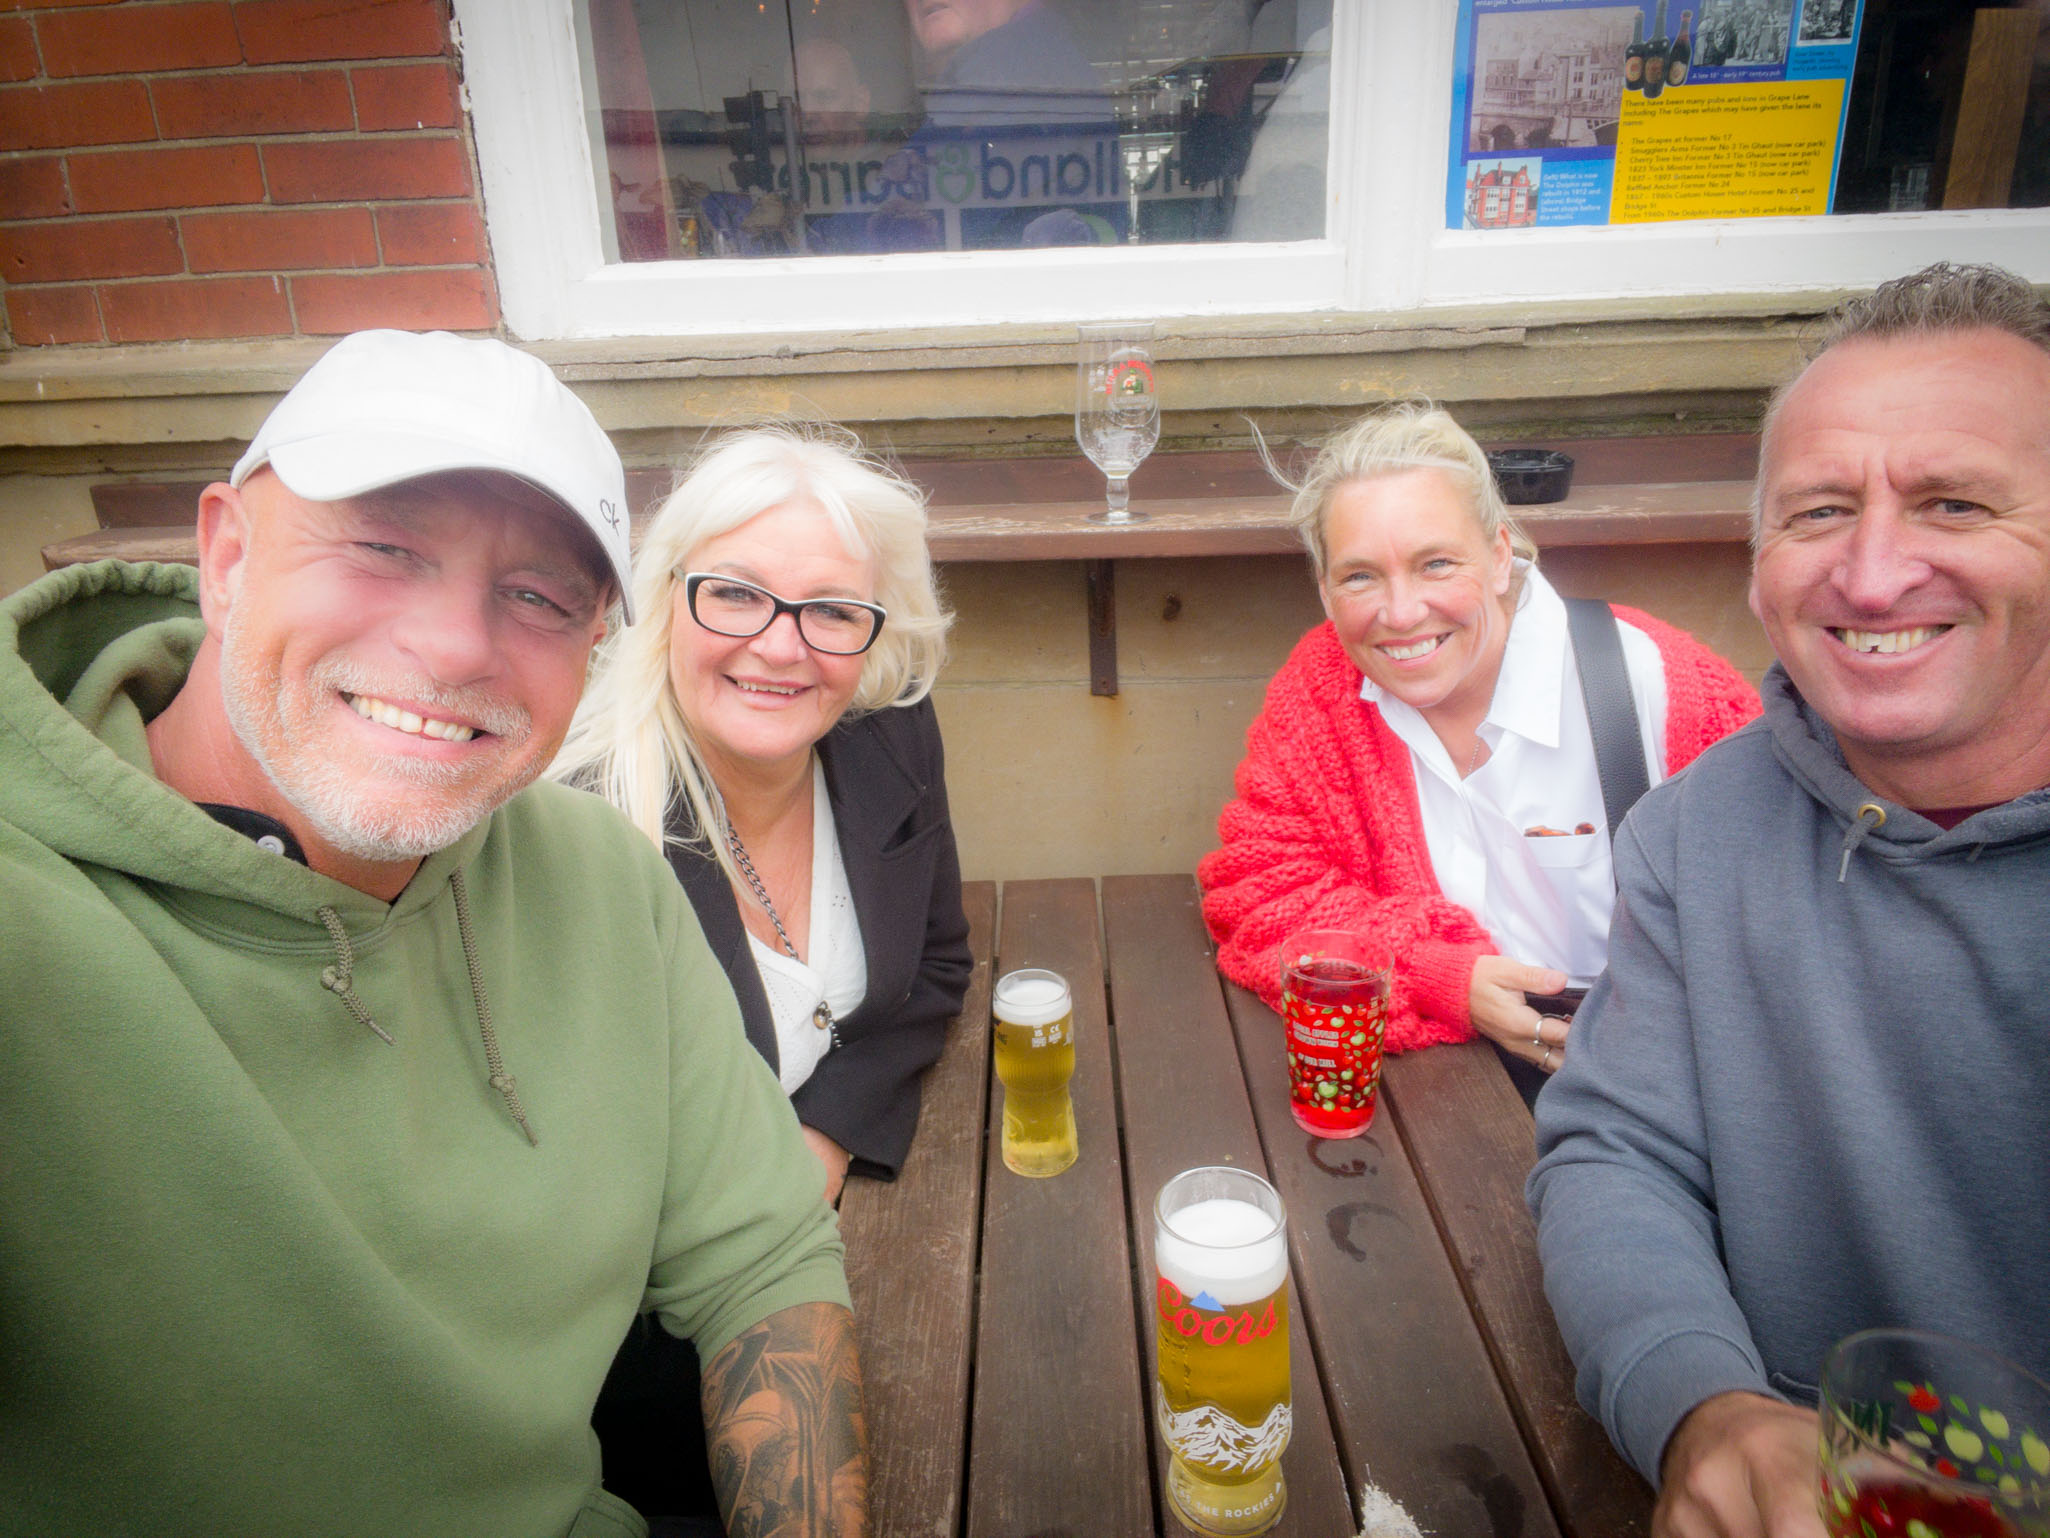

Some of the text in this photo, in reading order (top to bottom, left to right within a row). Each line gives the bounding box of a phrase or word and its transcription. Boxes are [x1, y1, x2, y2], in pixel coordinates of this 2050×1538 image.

[1156, 1276, 1279, 1347] Coors
[1197, 1500, 1220, 1518] THE
[1224, 1492, 1275, 1519] ROCKIES
